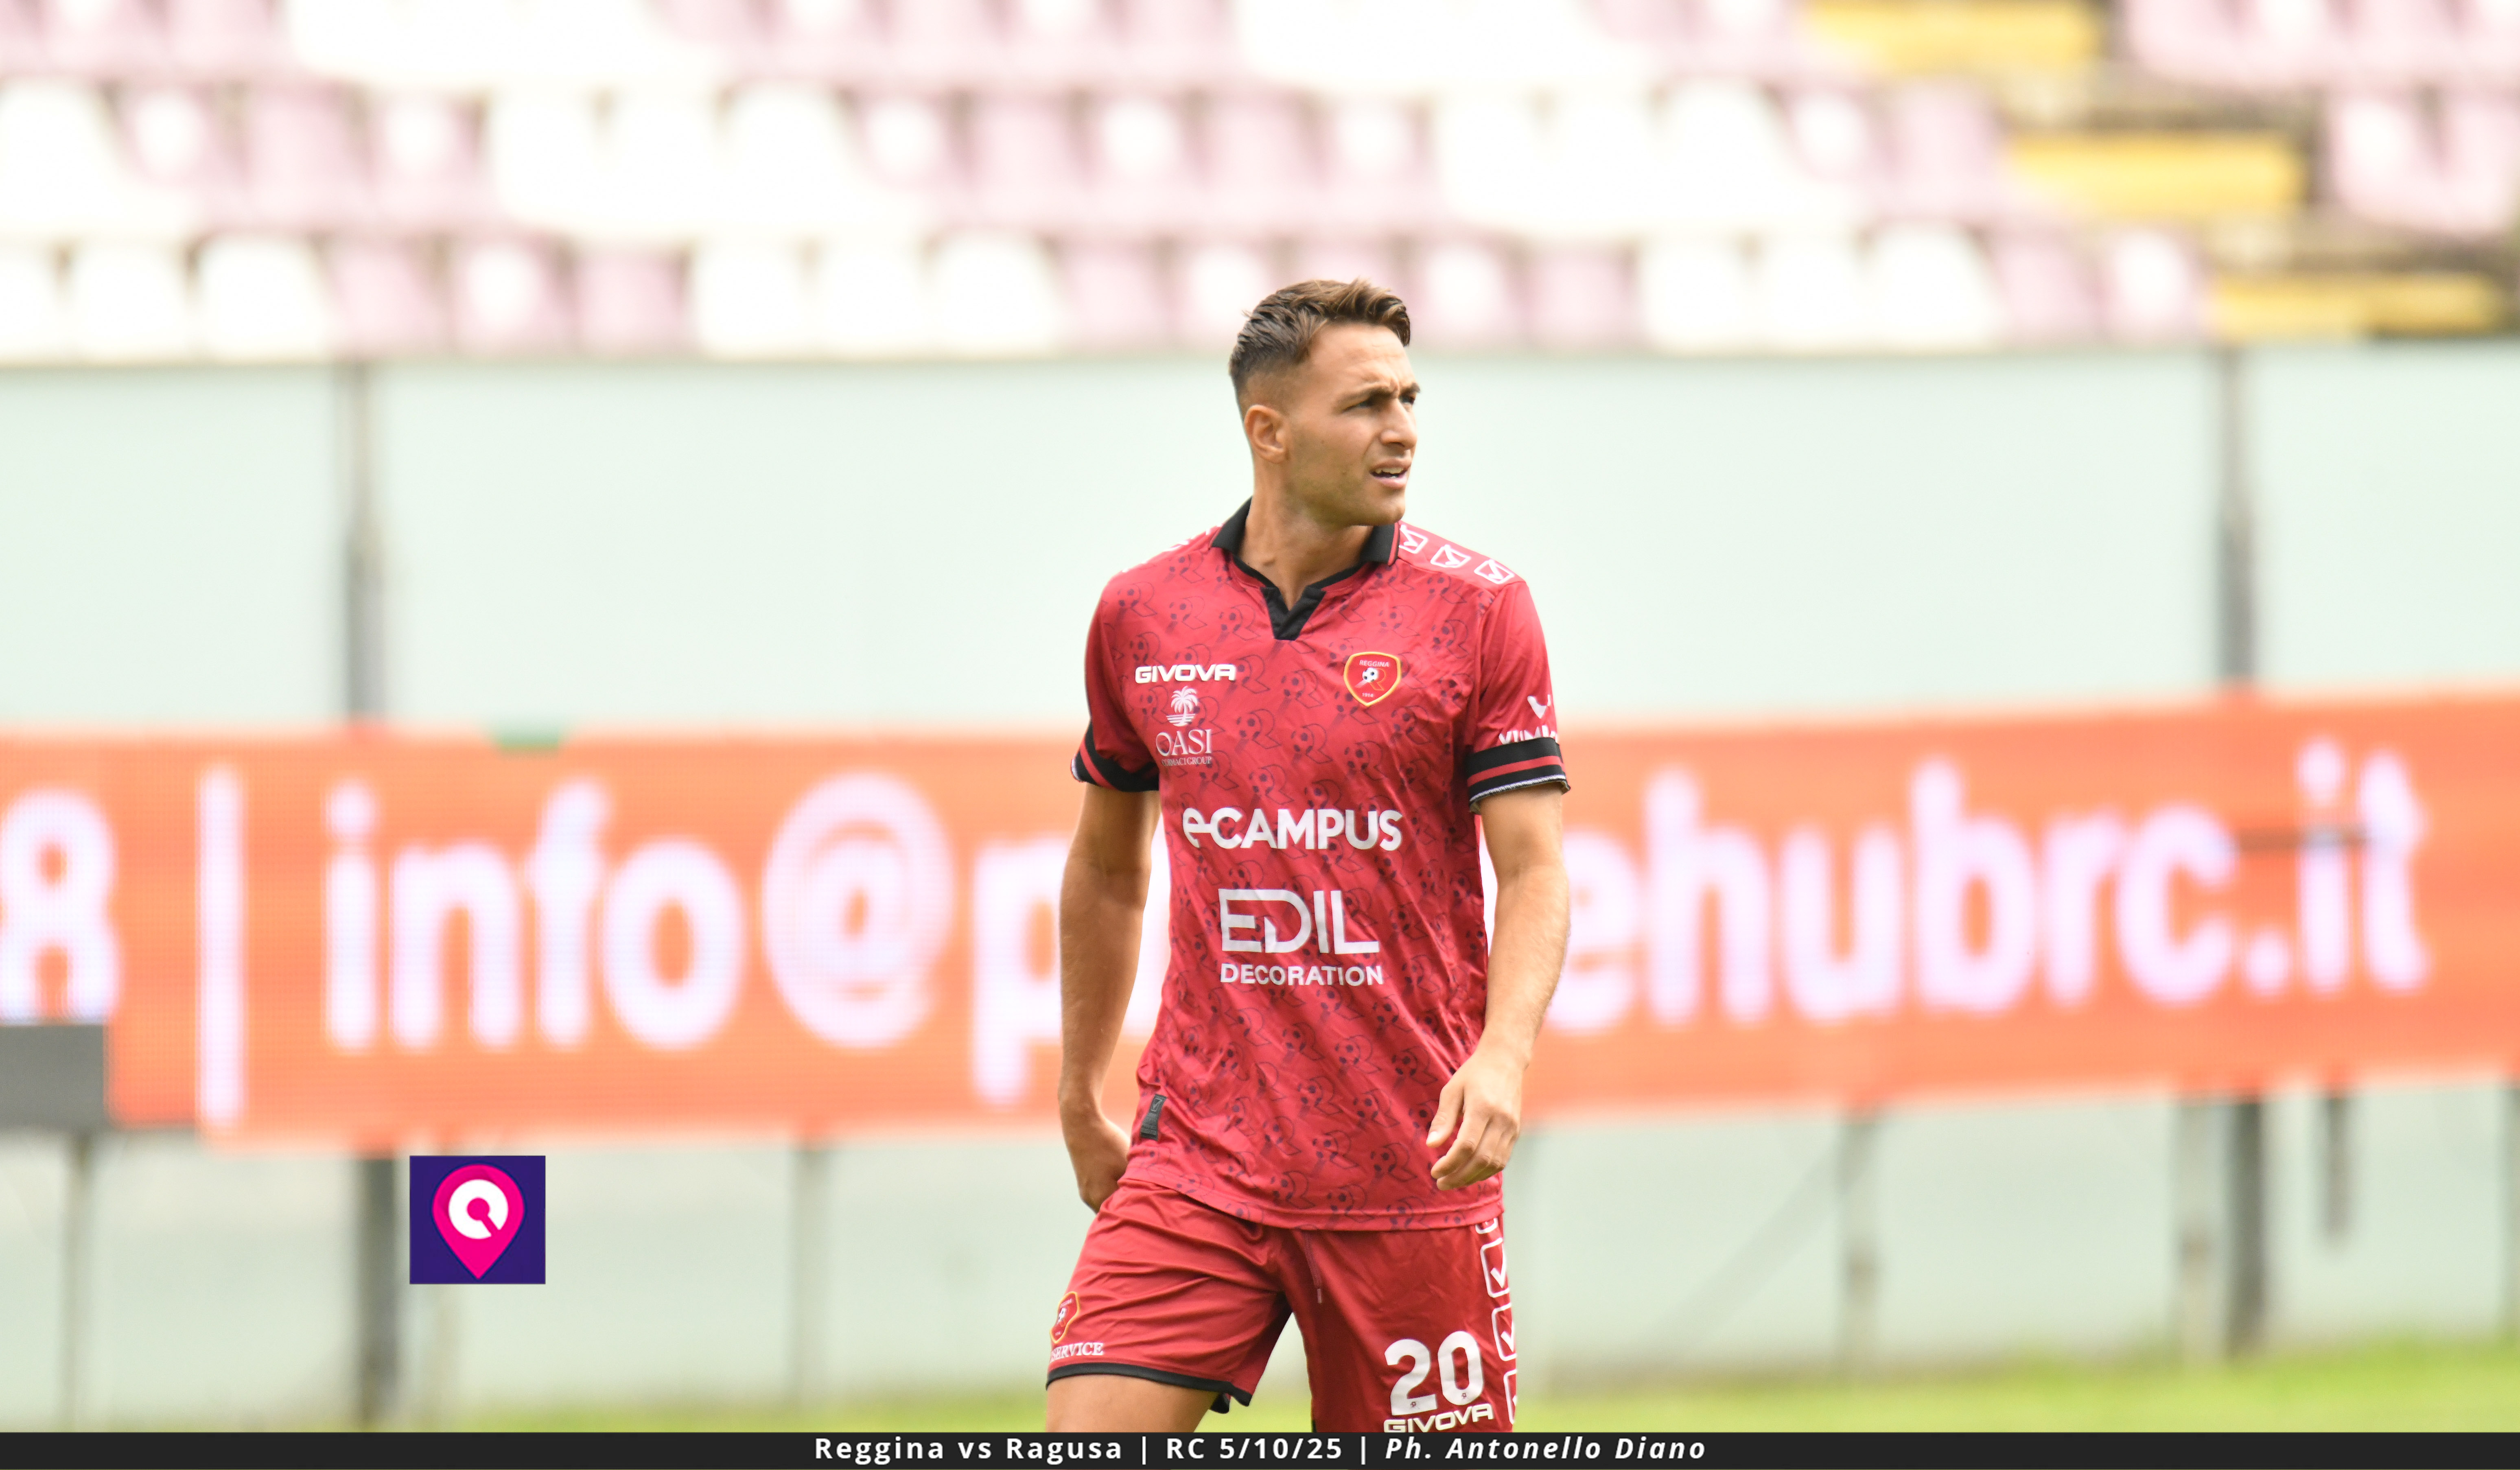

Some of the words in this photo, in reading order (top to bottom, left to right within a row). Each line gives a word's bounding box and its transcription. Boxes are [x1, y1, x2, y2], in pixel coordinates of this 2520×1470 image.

[1135, 664, 1237, 684] GIVOVA
[1155, 729, 1212, 756] OASI
[1186, 756, 1212, 765] GROUP
[1218, 888, 1380, 954] EDIL
[1220, 963, 1384, 986] DECORATION
[1384, 1330, 1484, 1415] 20
[1384, 1403, 1494, 1433] GIVOVA
